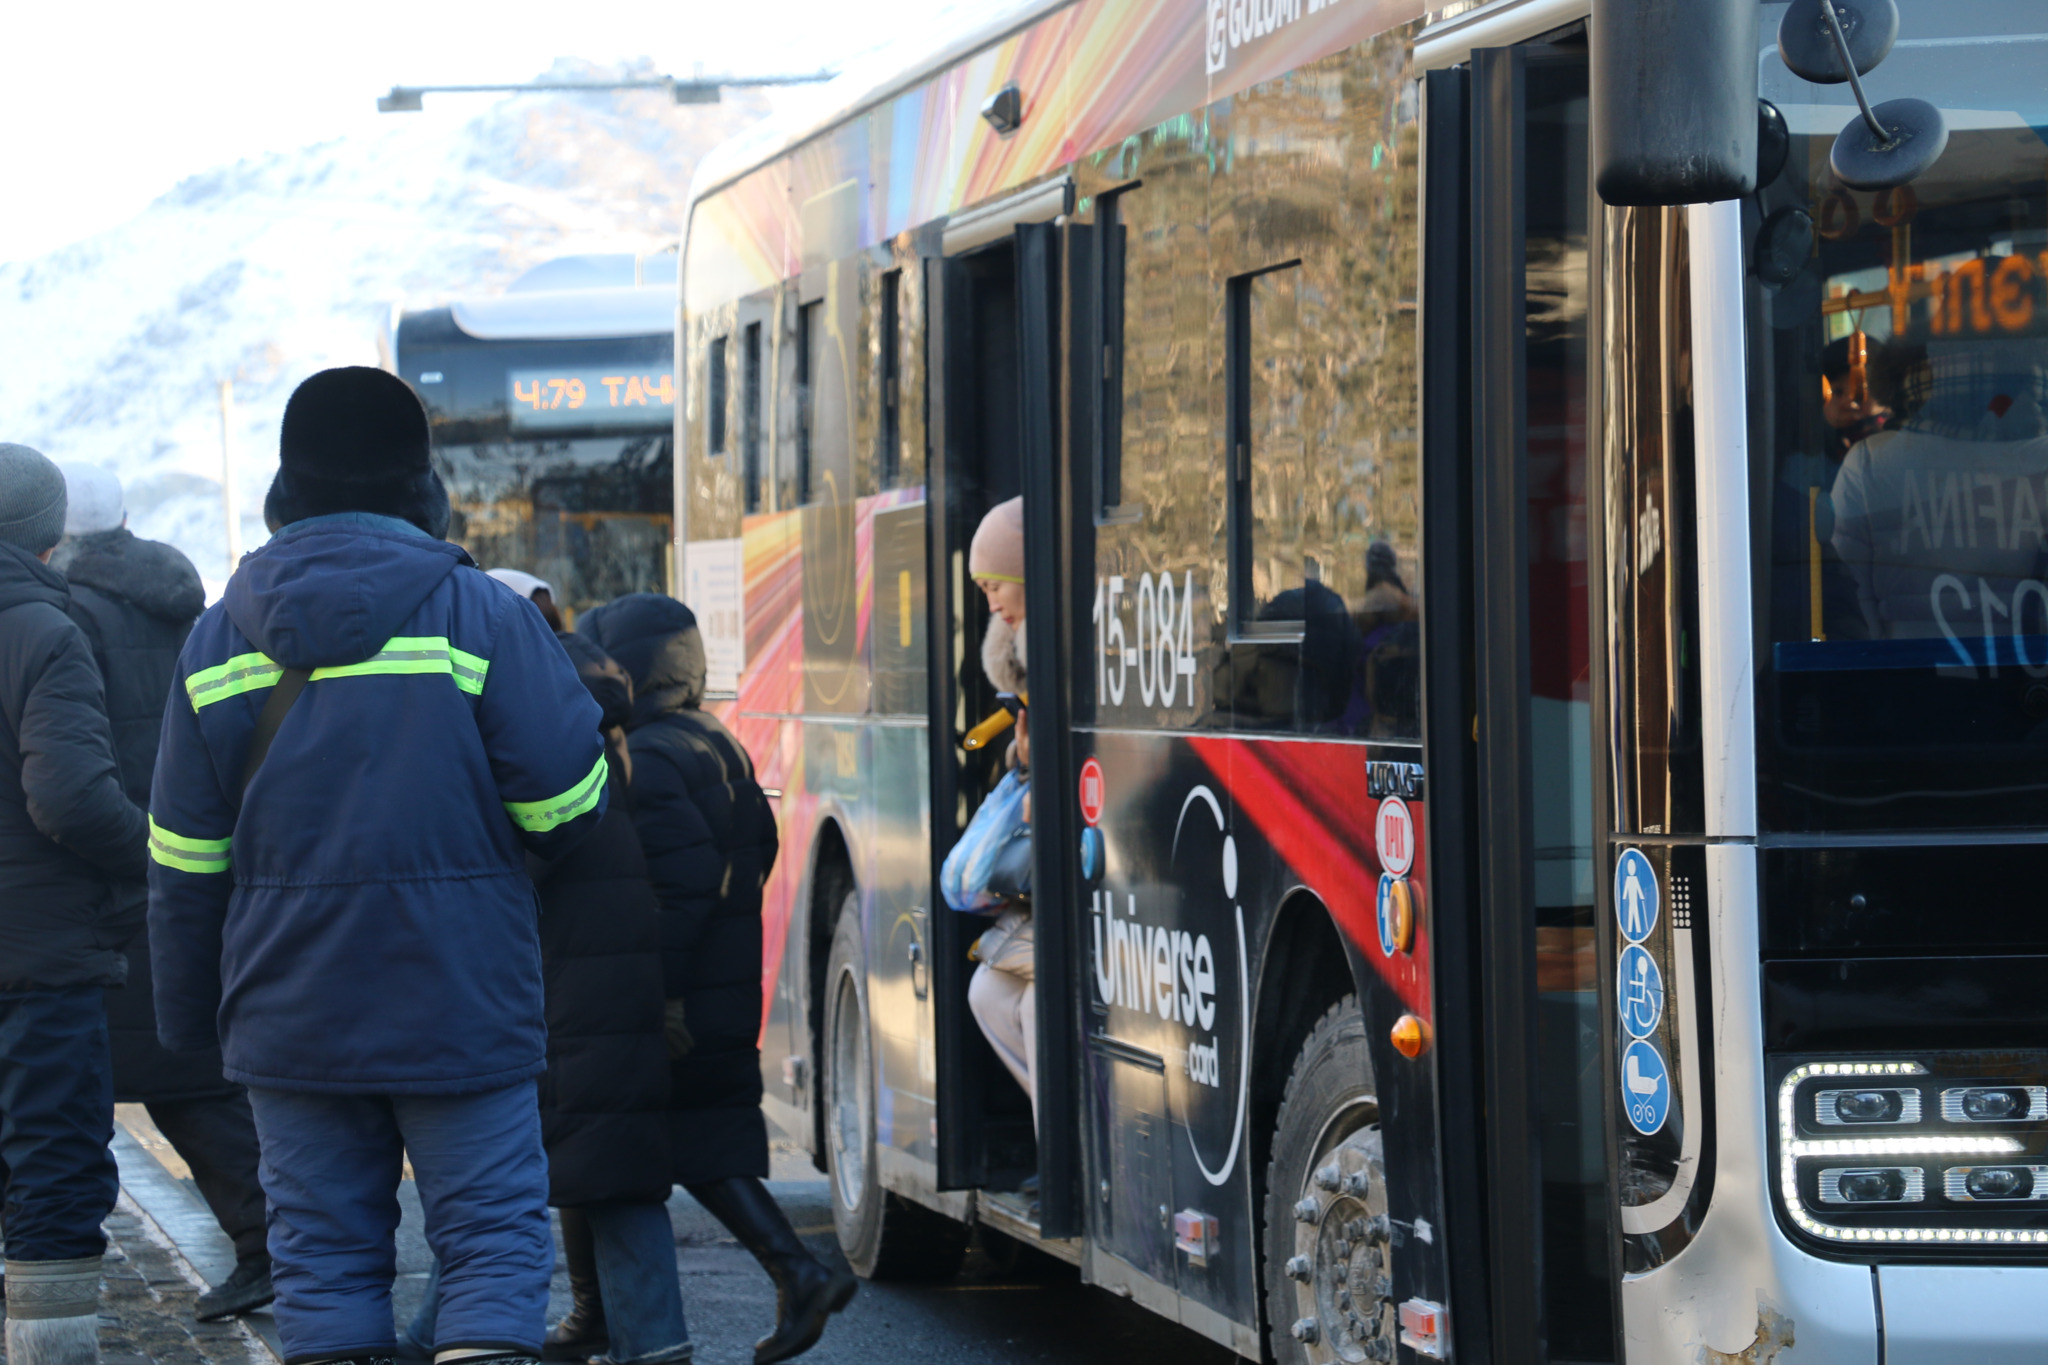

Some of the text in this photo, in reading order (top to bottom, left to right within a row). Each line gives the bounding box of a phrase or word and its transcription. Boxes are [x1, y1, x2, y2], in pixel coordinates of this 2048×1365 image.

[1092, 568, 1197, 709] 15-084
[1092, 888, 1217, 1032] Universe
[1188, 1035, 1220, 1089] card
